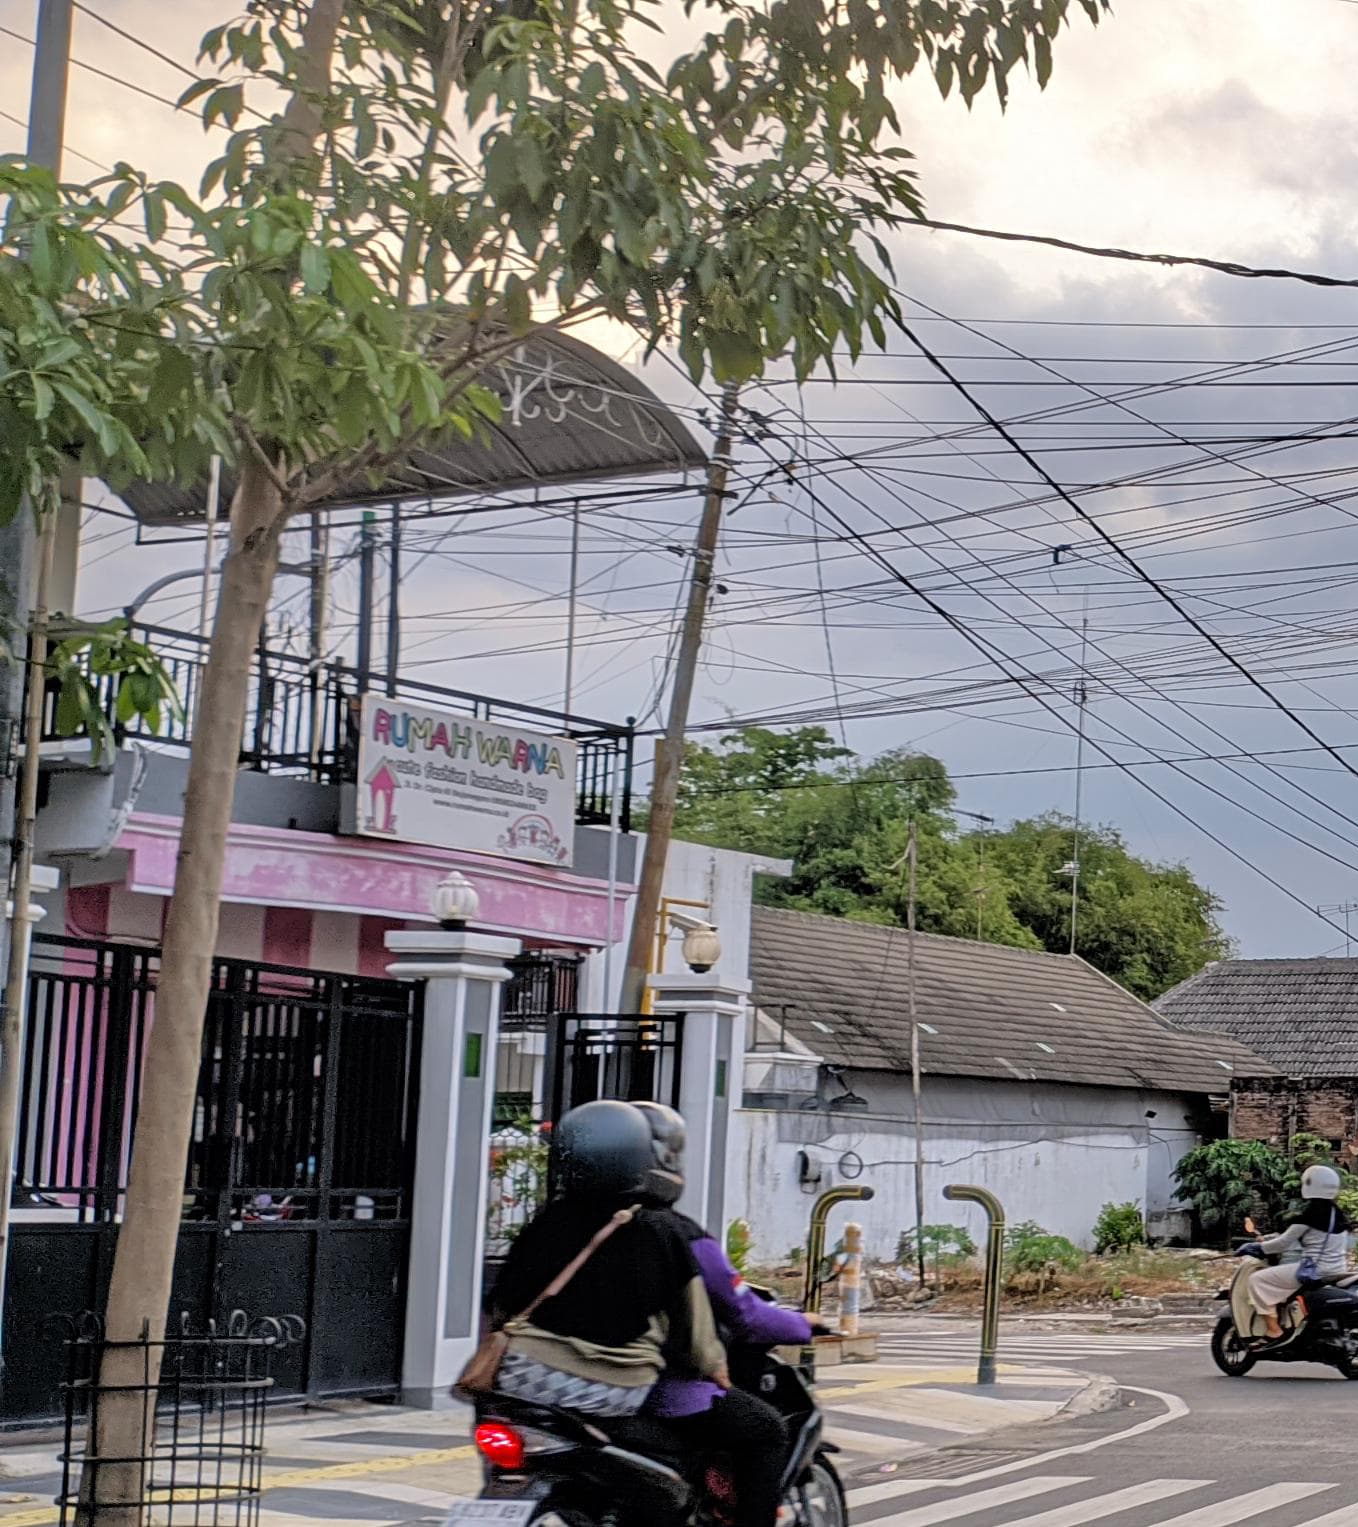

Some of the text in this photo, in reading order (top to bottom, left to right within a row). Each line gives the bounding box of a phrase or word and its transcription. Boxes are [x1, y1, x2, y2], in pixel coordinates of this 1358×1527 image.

[373, 708, 565, 780] RUMAH WARNA
[424, 761, 467, 785] fashion
[470, 769, 524, 796] handmade
[527, 781, 548, 805] bag
